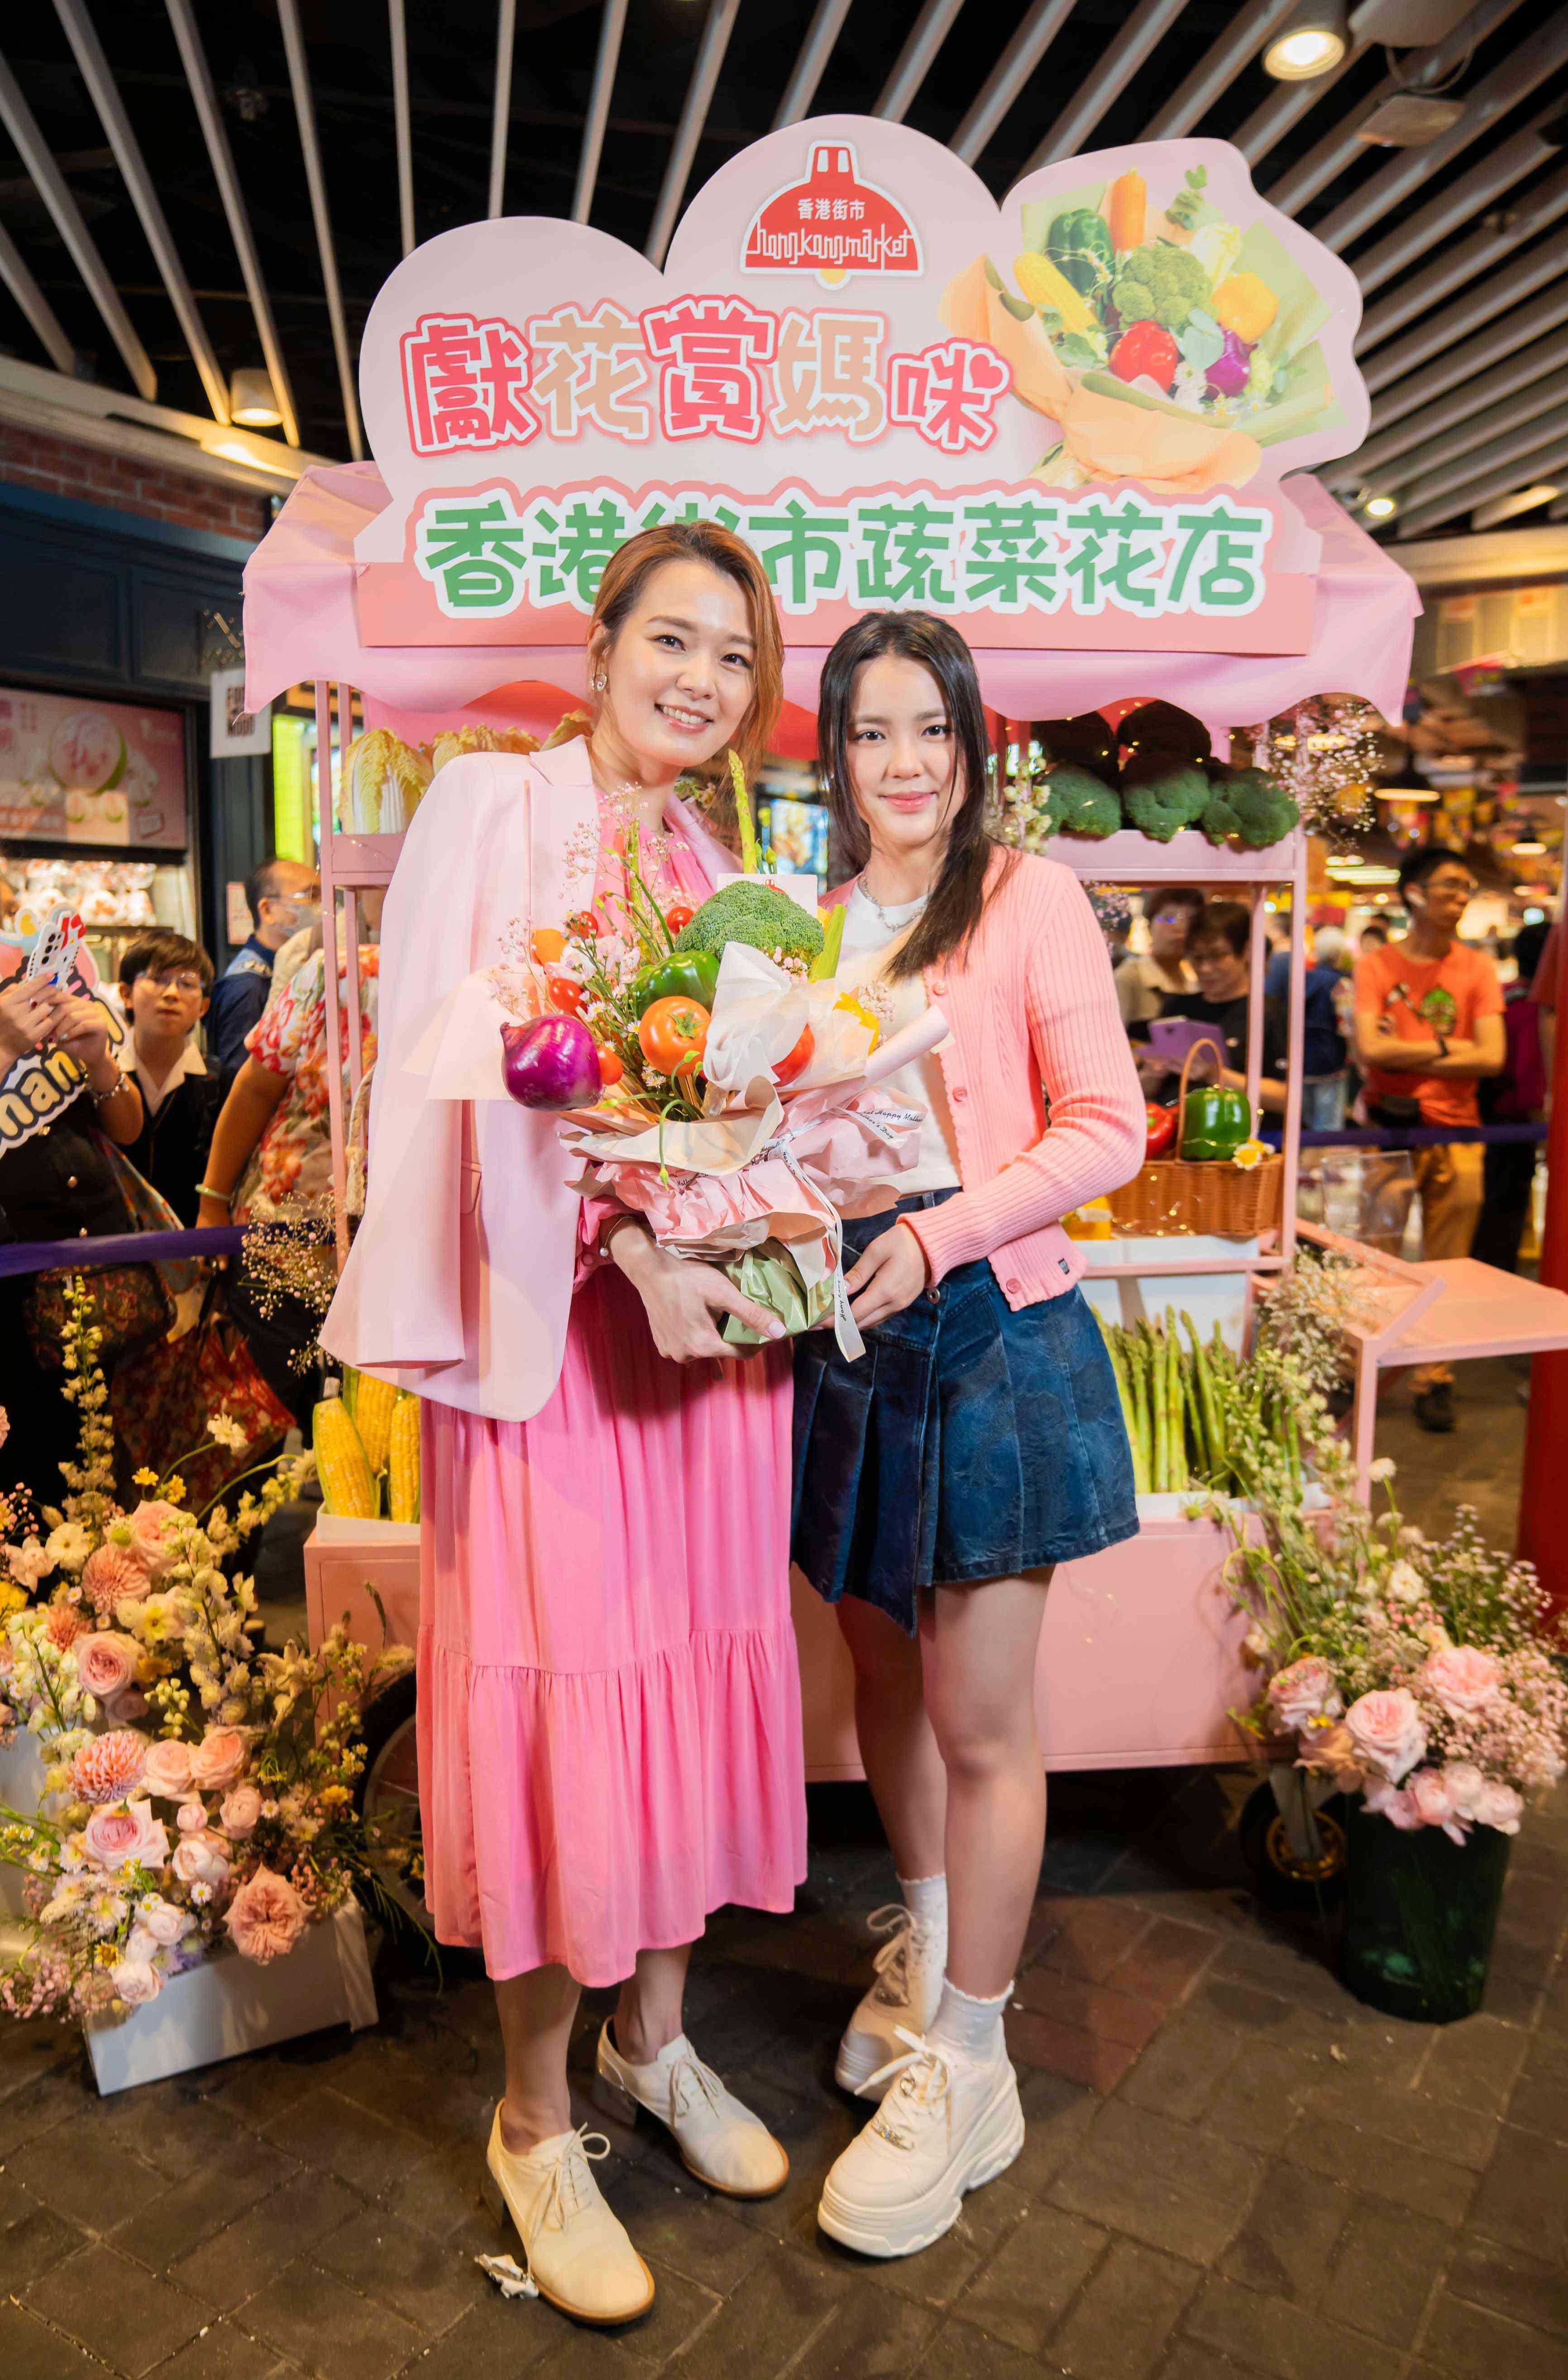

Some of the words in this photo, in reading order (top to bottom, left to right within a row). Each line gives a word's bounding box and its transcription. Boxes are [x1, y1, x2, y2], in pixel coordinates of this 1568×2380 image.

[798, 198, 865, 221] 香港街市
[402, 294, 1009, 453] 獻花賞媽咪
[425, 498, 1263, 609] 香港市蔬菜花店
